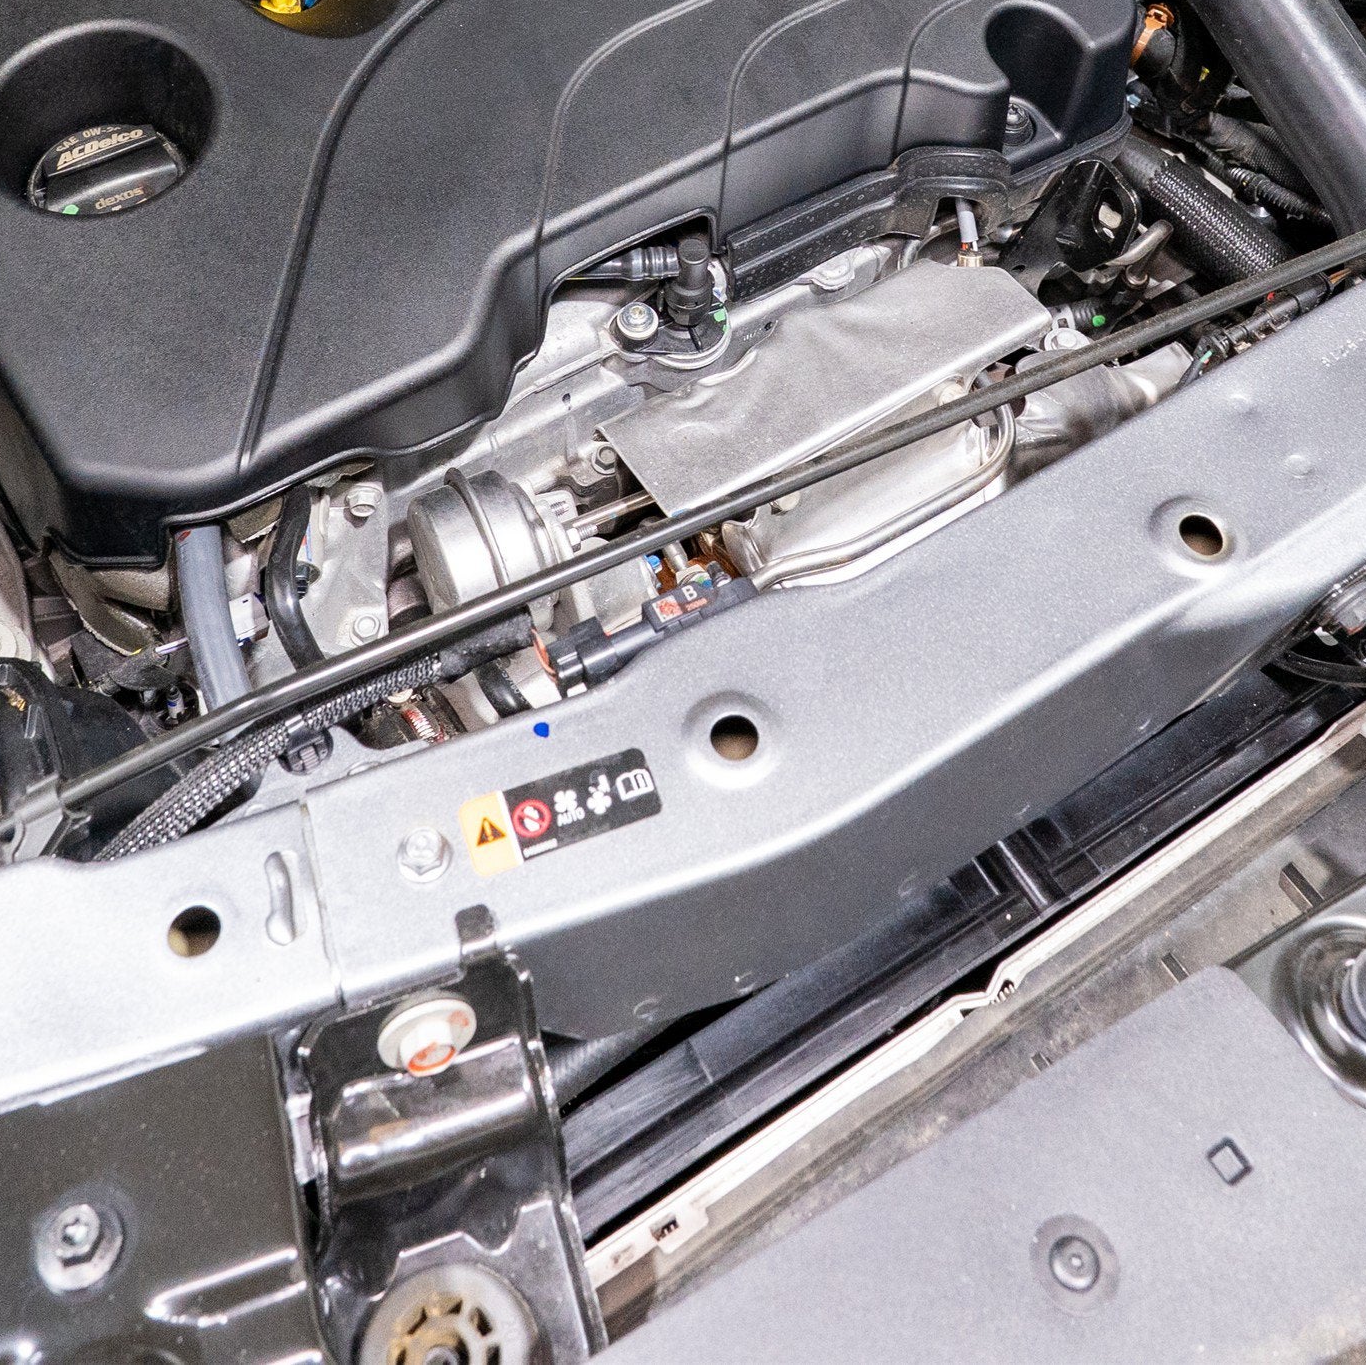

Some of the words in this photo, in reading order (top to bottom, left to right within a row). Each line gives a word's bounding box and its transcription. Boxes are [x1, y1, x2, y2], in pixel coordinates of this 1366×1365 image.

[56, 128, 147, 170] ACDelco
[95, 186, 145, 210] dexos
[681, 584, 698, 602] B
[557, 806, 585, 828] AUTO
